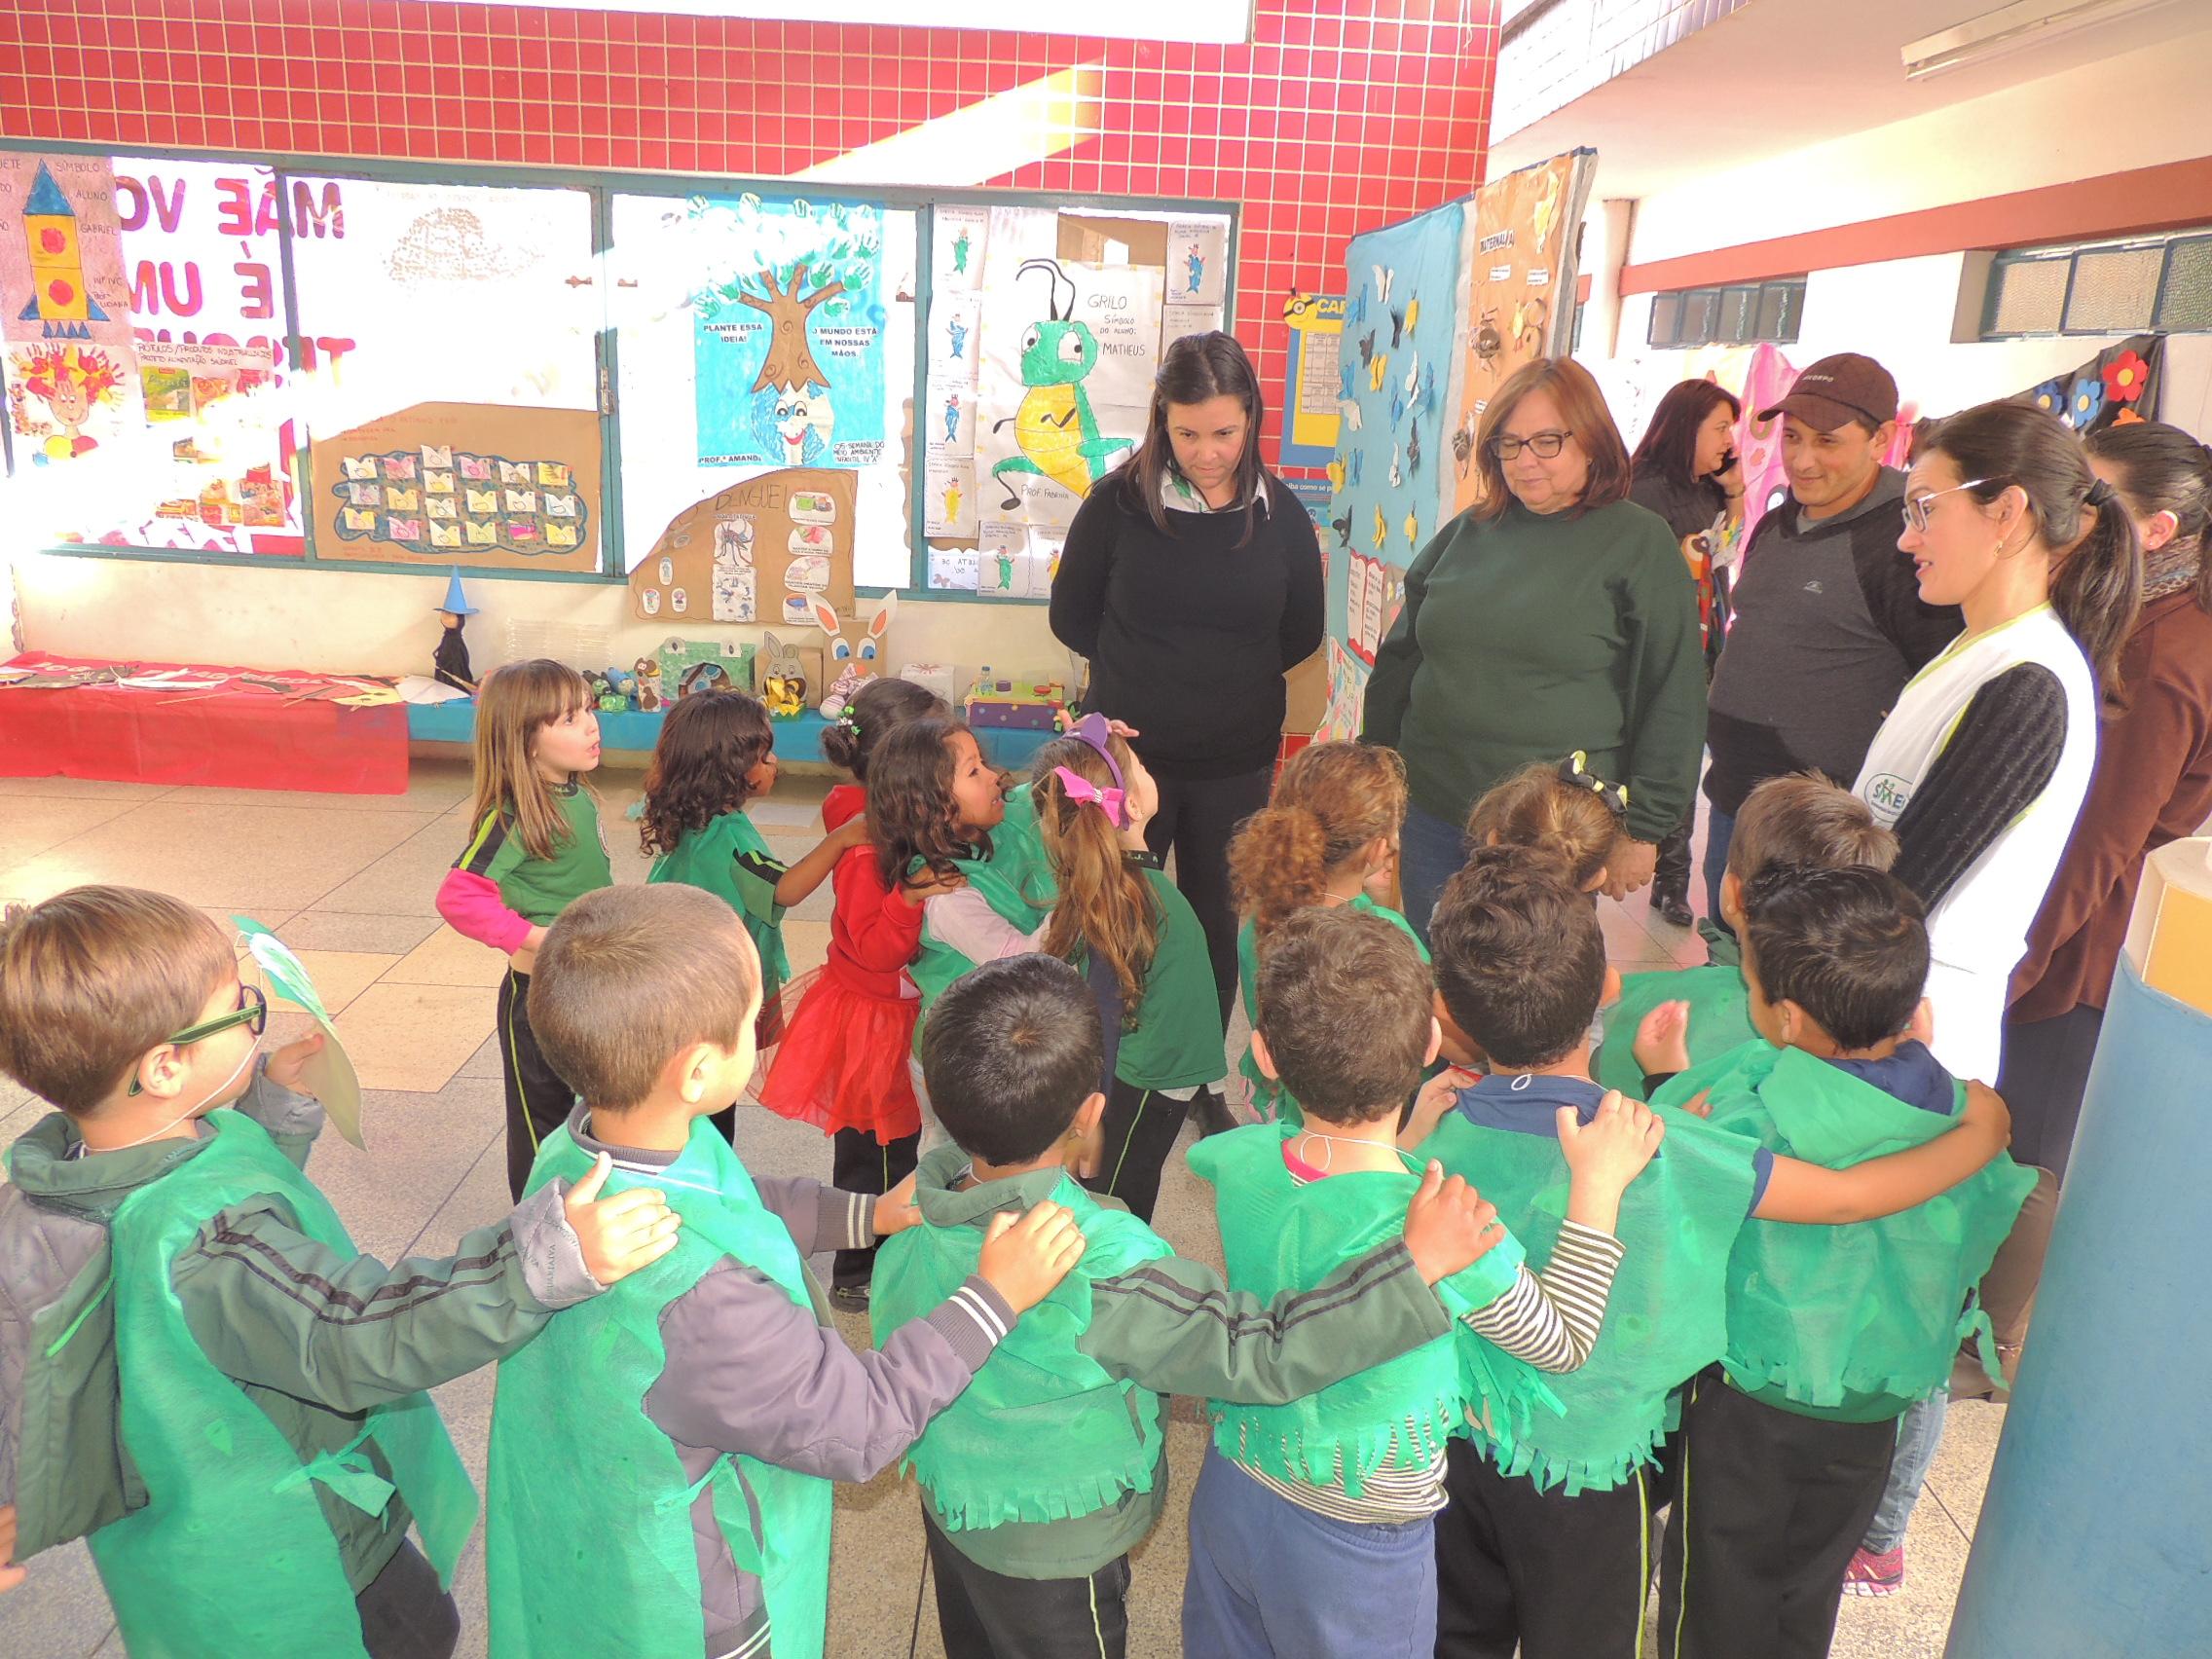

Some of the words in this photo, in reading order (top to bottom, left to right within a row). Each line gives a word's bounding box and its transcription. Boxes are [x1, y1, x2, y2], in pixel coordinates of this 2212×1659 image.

[76, 190, 108, 201] ALUNO
[80, 223, 118, 237] GABRIEL
[1088, 293, 1127, 311] GRILO
[739, 323, 763, 332] ESSA
[1102, 342, 1146, 356] MATHEUS
[716, 484, 789, 513] DENGUE!
